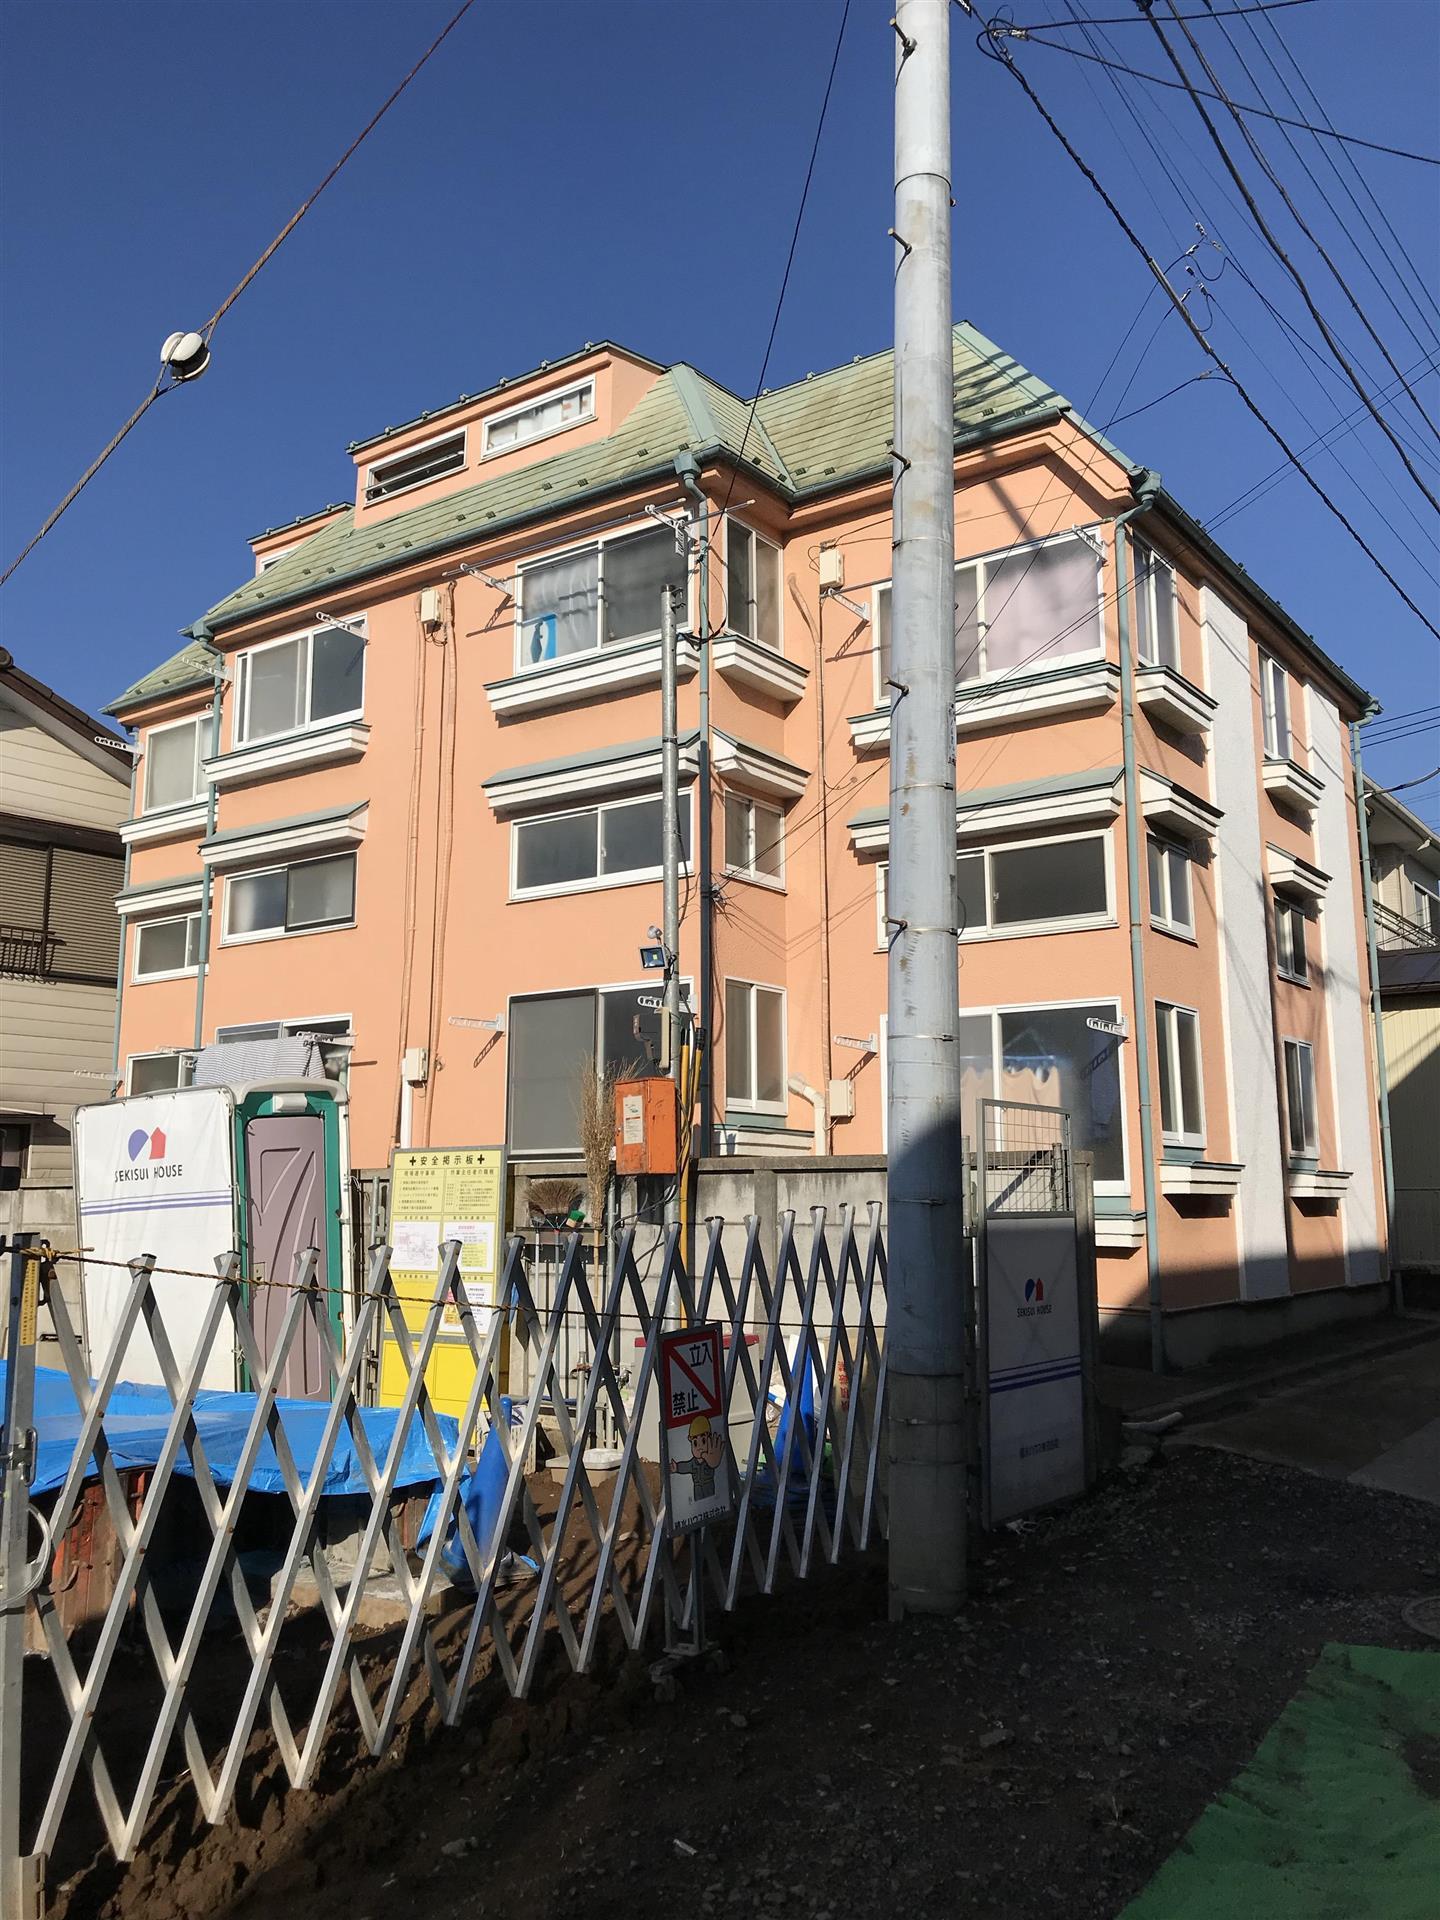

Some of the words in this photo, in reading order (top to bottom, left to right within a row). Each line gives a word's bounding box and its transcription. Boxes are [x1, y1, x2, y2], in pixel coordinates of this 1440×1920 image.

[420, 1155, 474, 1166] 安全掲示板
[115, 1168, 149, 1183] SEKISUI
[154, 1164, 183, 1179] HOUSE
[689, 1343, 713, 1367] 立入
[673, 1388, 699, 1416] 禁止
